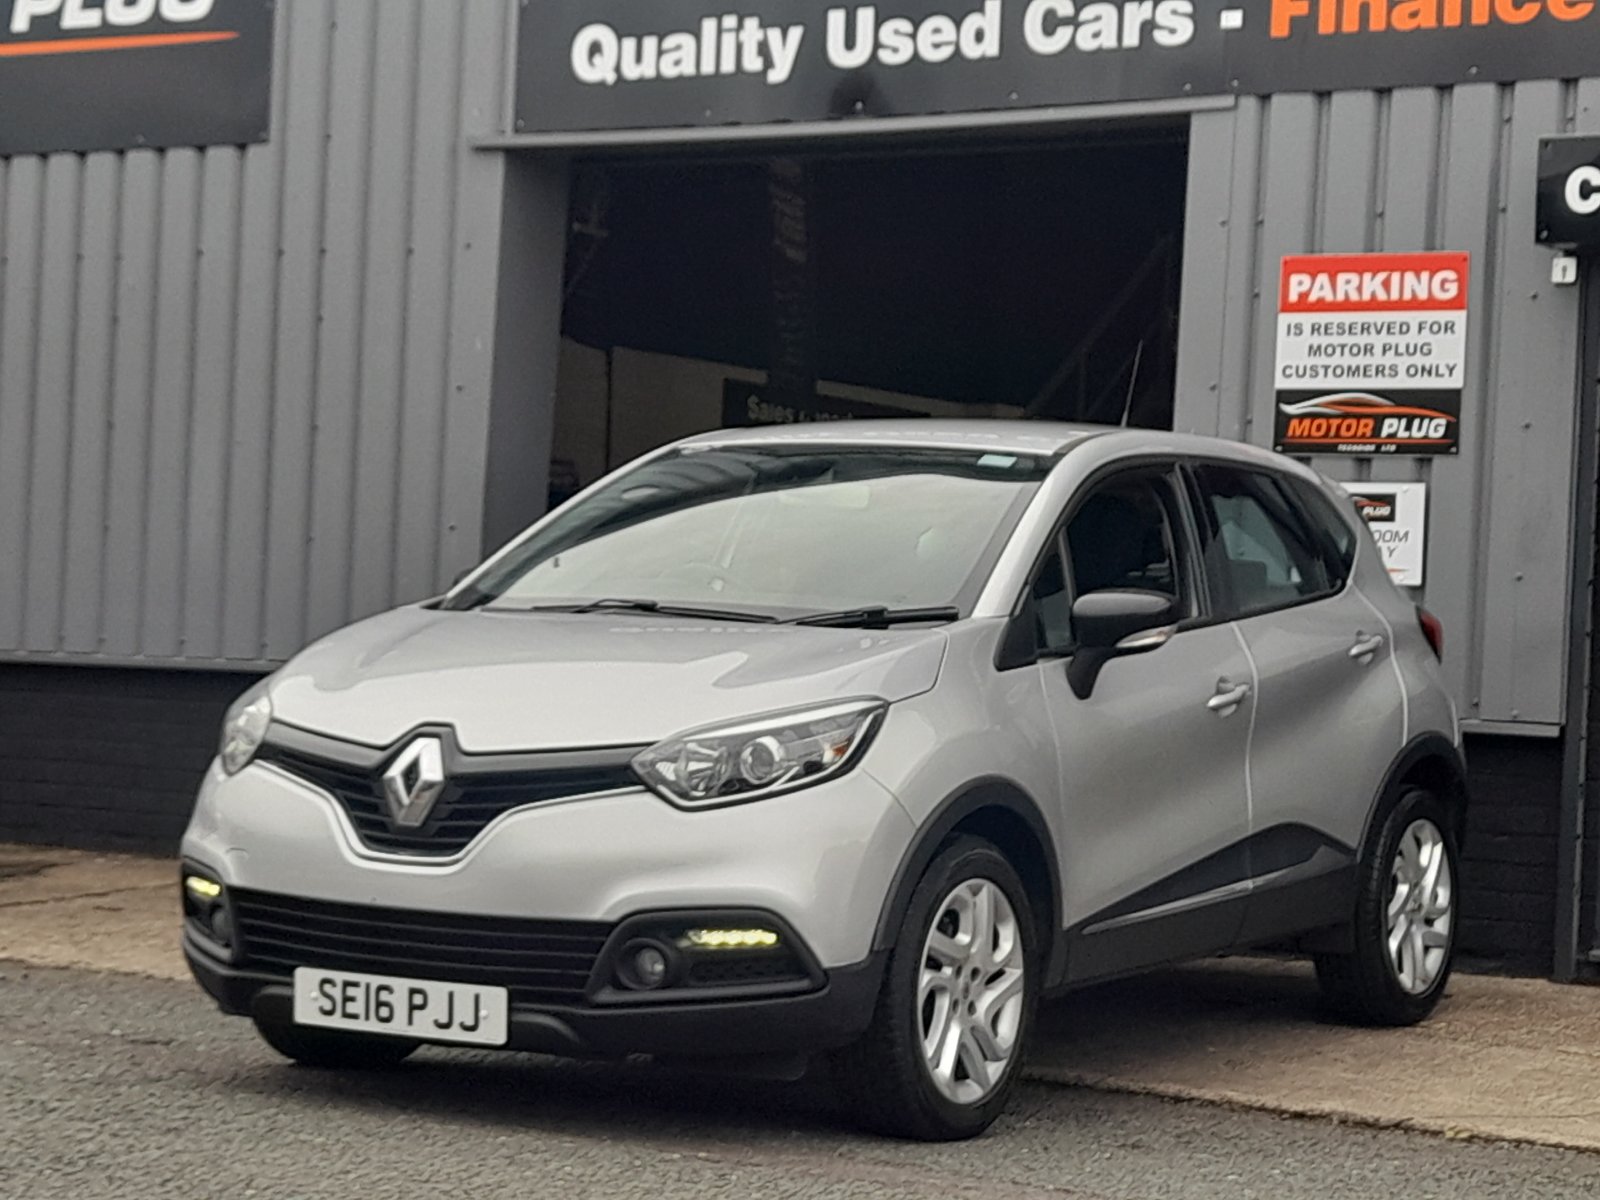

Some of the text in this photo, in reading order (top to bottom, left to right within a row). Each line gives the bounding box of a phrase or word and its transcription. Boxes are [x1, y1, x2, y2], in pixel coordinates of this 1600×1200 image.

[571, 14, 804, 85] Quality
[826, 0, 1000, 68] Used
[1024, 0, 1195, 55] Cars
[1219, 8, 1243, 29] -
[1288, 269, 1459, 303] PARKING
[1286, 320, 1456, 337] IS RESERVED FOR
[1307, 342, 1433, 358] MOTOR PLUG
[1282, 363, 1458, 379] CUSTOMERS ONLY
[1287, 417, 1448, 438] MOTOR PLUG
[318, 977, 481, 1032] SE16 PJJ
